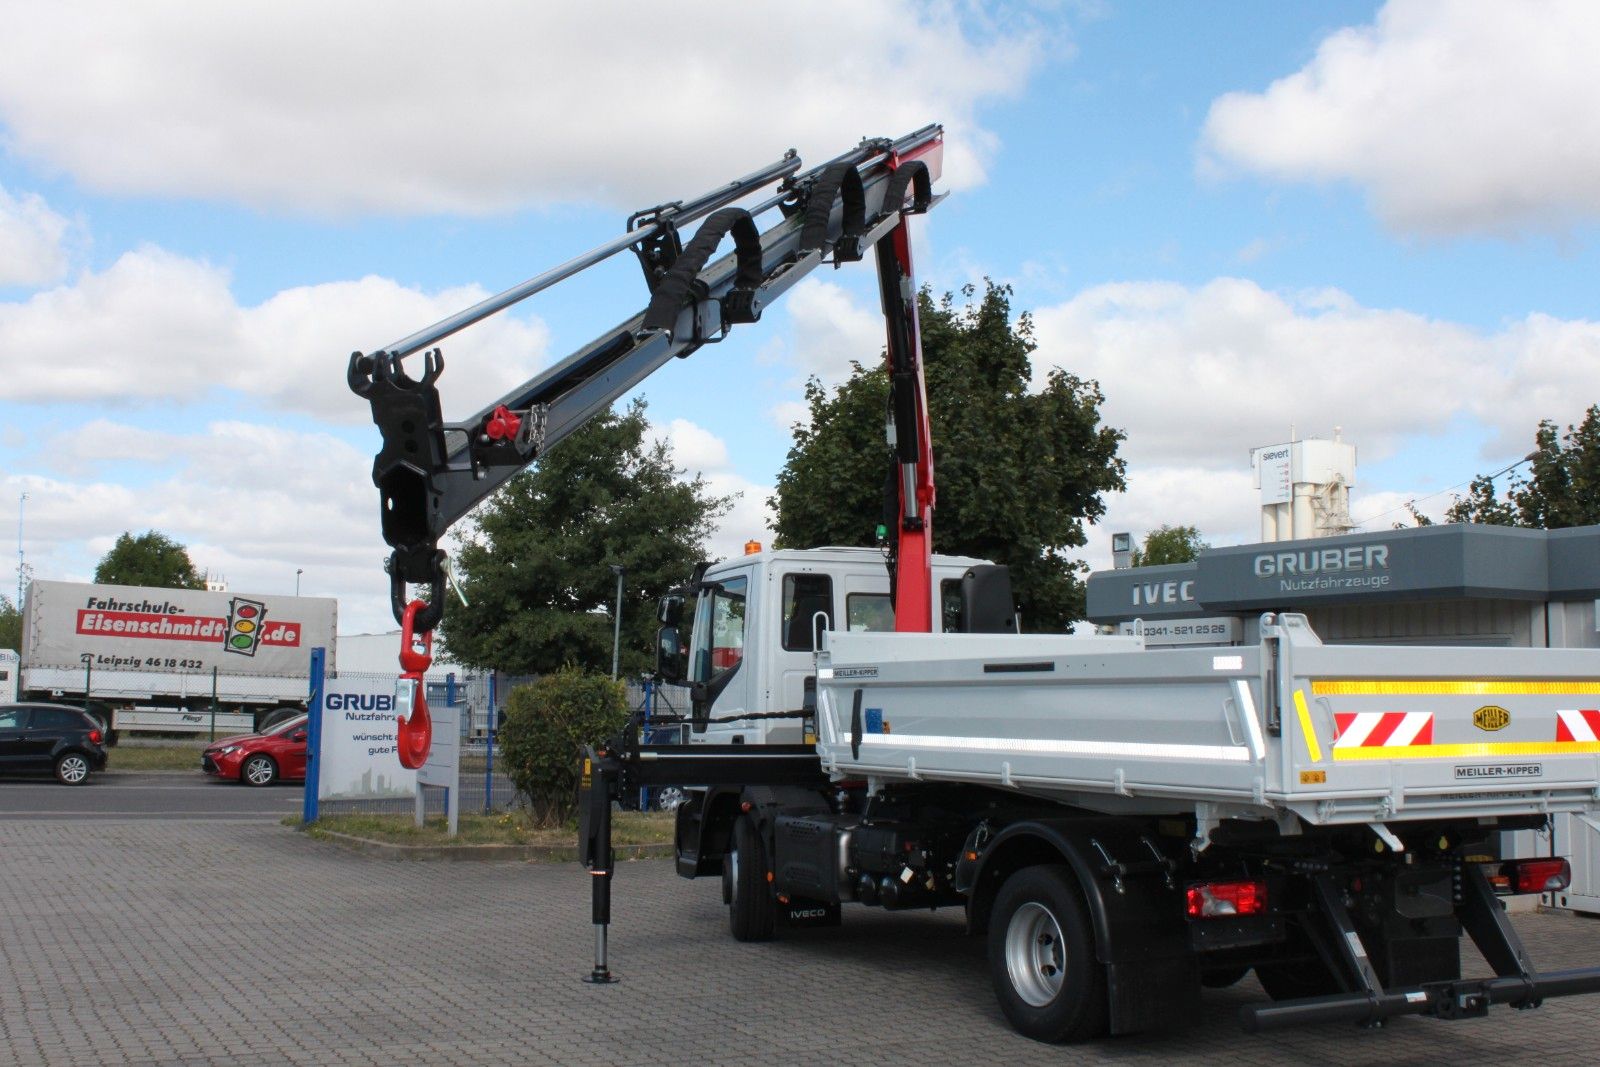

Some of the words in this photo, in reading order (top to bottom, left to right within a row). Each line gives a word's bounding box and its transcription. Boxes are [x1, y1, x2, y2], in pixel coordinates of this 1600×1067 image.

[1263, 449, 1289, 461] sievert
[1254, 545, 1389, 577] GRUBER
[1280, 576, 1390, 591] Nutzfahrzeuge
[87, 597, 185, 615] Fahrschule-
[81, 613, 223, 637] Eisenschmidt
[264, 625, 296, 642] .de
[1195, 625, 1210, 634] 25
[97, 655, 142, 668] Leipzig
[145, 657, 161, 667] 46
[164, 658, 177, 667] 18
[179, 659, 203, 669] 432
[834, 669, 878, 677] MEILLER-KIPPER
[353, 733, 393, 741] wünscht
[368, 746, 390, 755] gute
[1456, 766, 1540, 777] MEILLER-KIPPER
[791, 909, 826, 919] IVECO
